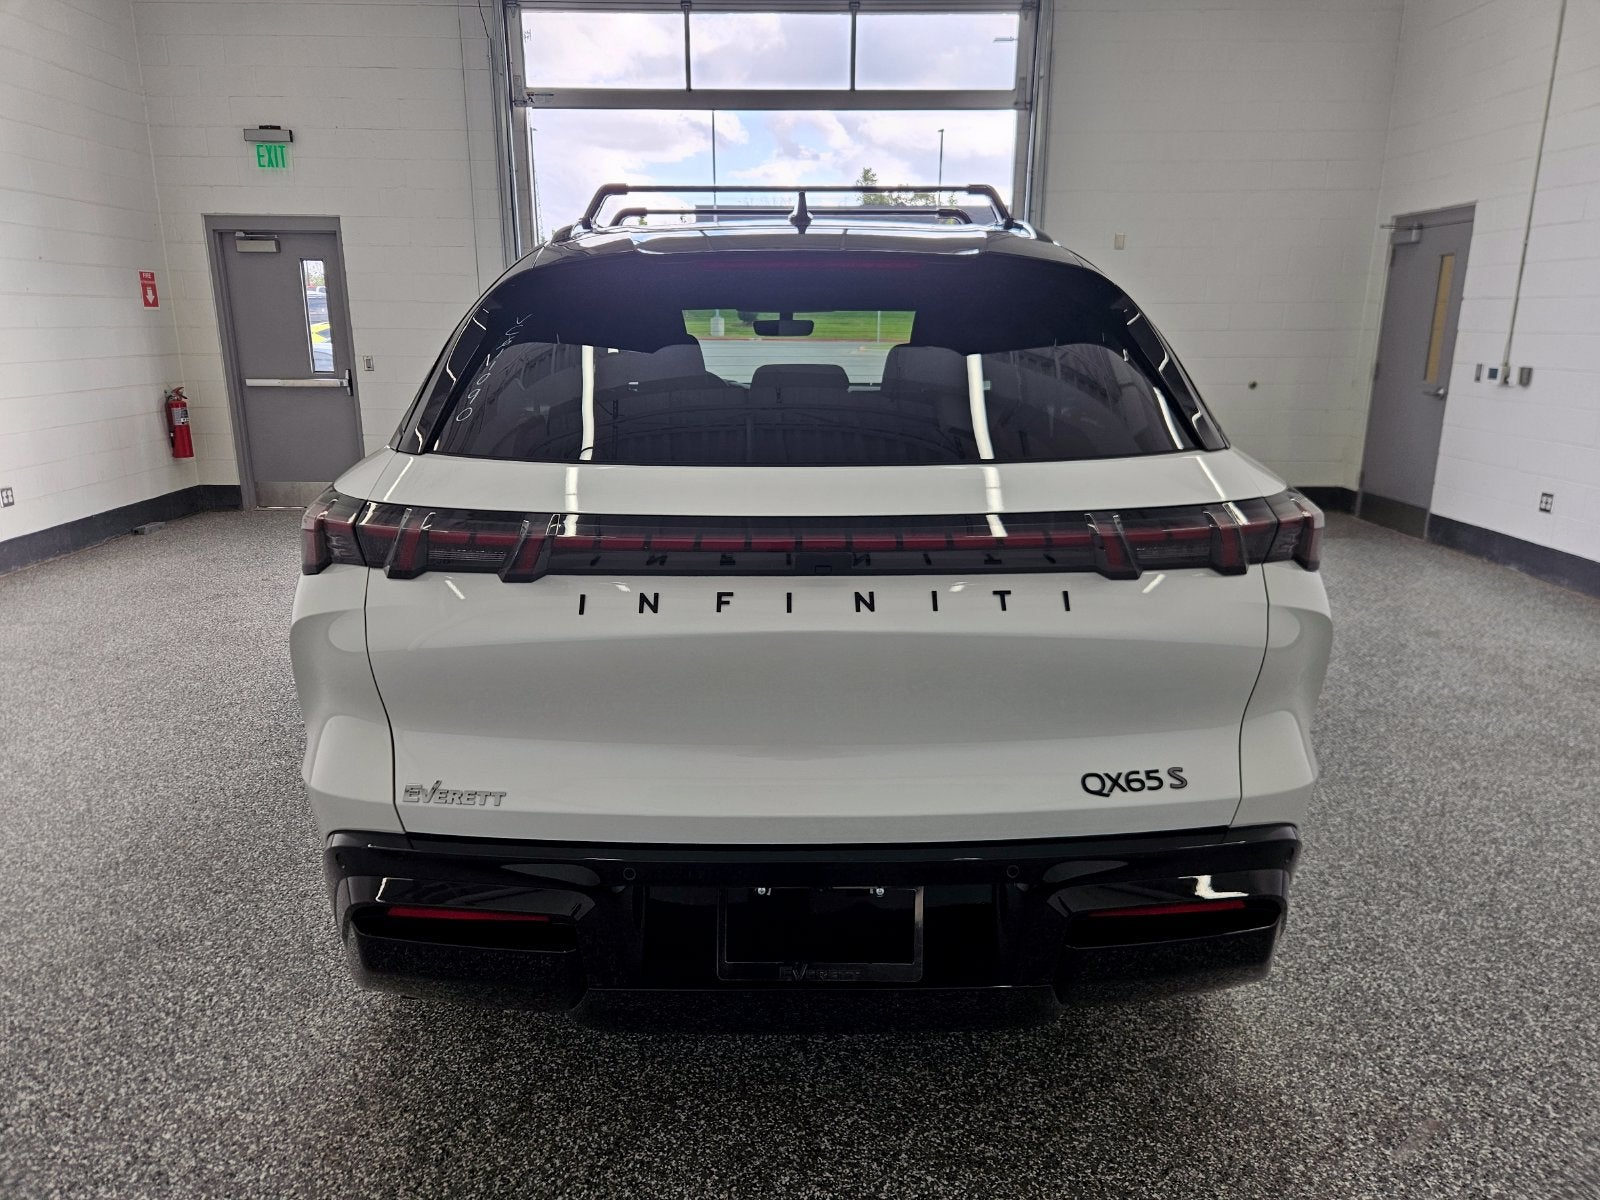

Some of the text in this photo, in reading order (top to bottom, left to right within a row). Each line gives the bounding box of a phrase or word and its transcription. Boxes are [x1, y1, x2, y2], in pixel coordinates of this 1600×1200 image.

[256, 144, 286, 168] EXIT
[578, 590, 1071, 616] INFINITI
[402, 780, 507, 807] EVERETT
[1081, 766, 1188, 798] QX65 S
